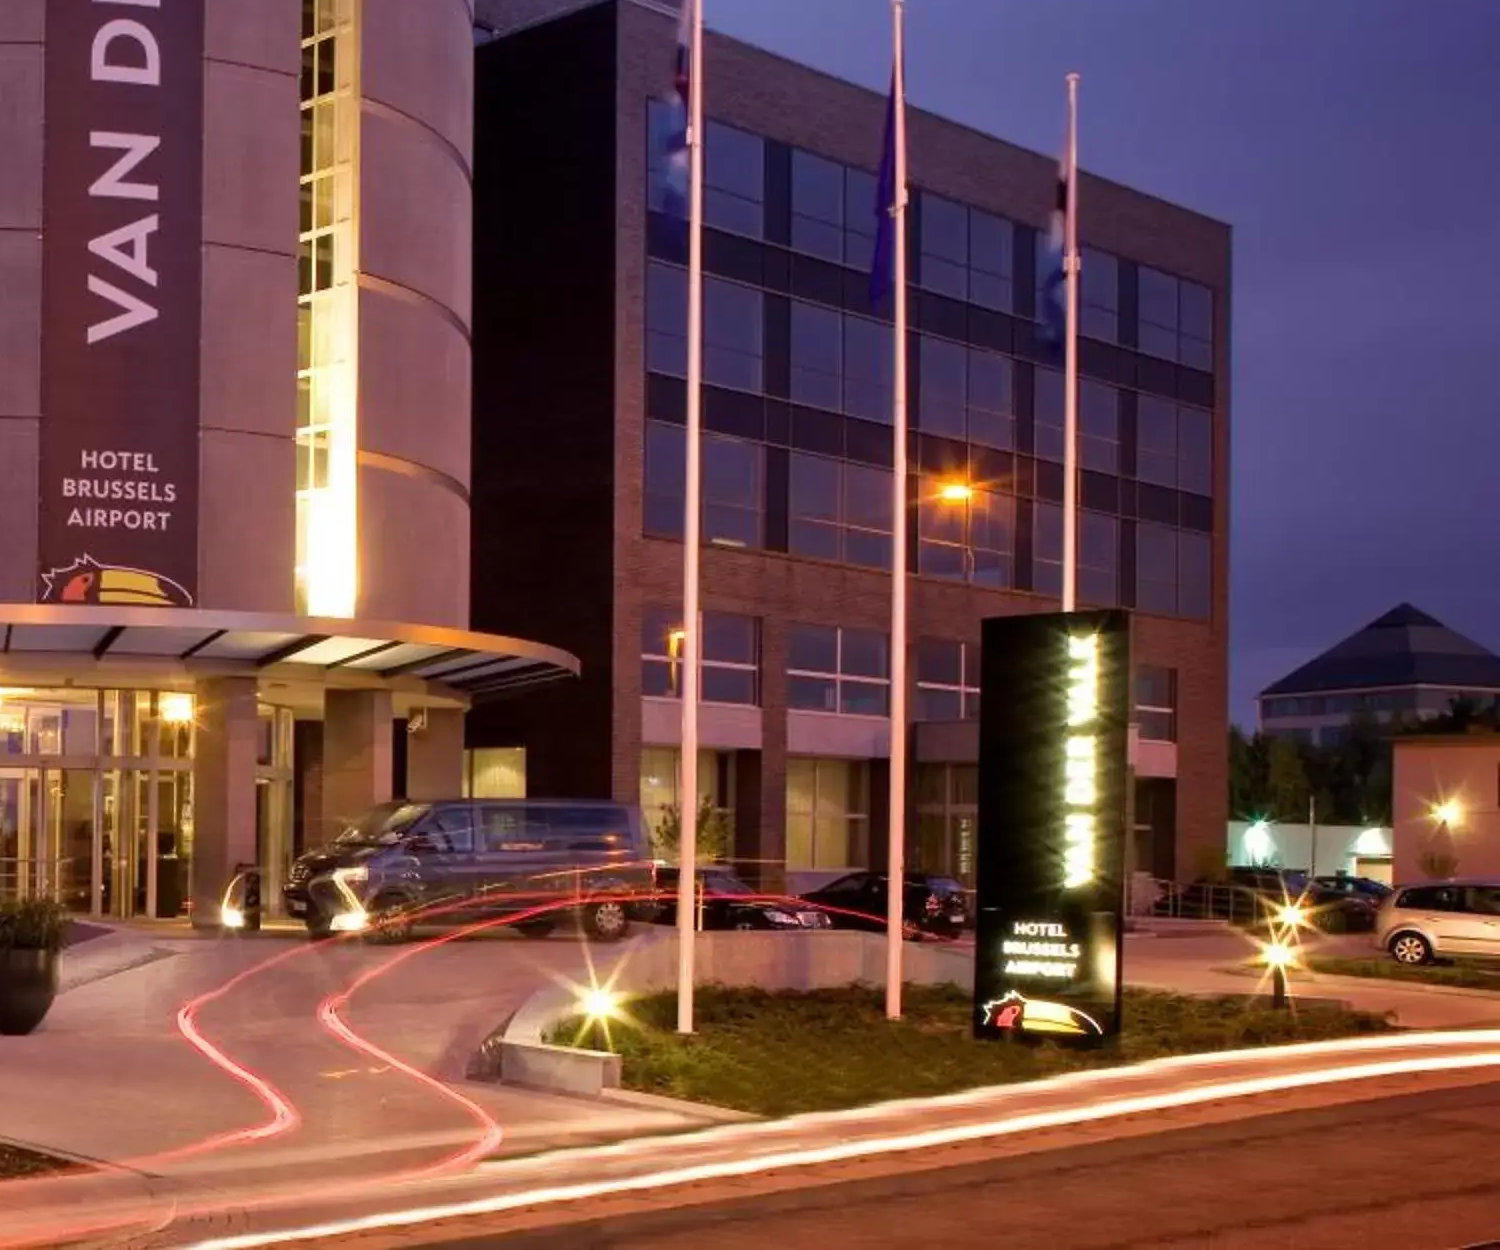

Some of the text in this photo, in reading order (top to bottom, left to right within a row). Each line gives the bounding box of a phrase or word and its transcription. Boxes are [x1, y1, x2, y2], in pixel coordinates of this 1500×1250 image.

[87, 131, 161, 344] VAN
[81, 450, 159, 473] HOTEL
[62, 477, 177, 503] BRUSSELS
[67, 507, 171, 531] AIRPORT
[1013, 921, 1068, 938] HOTEL
